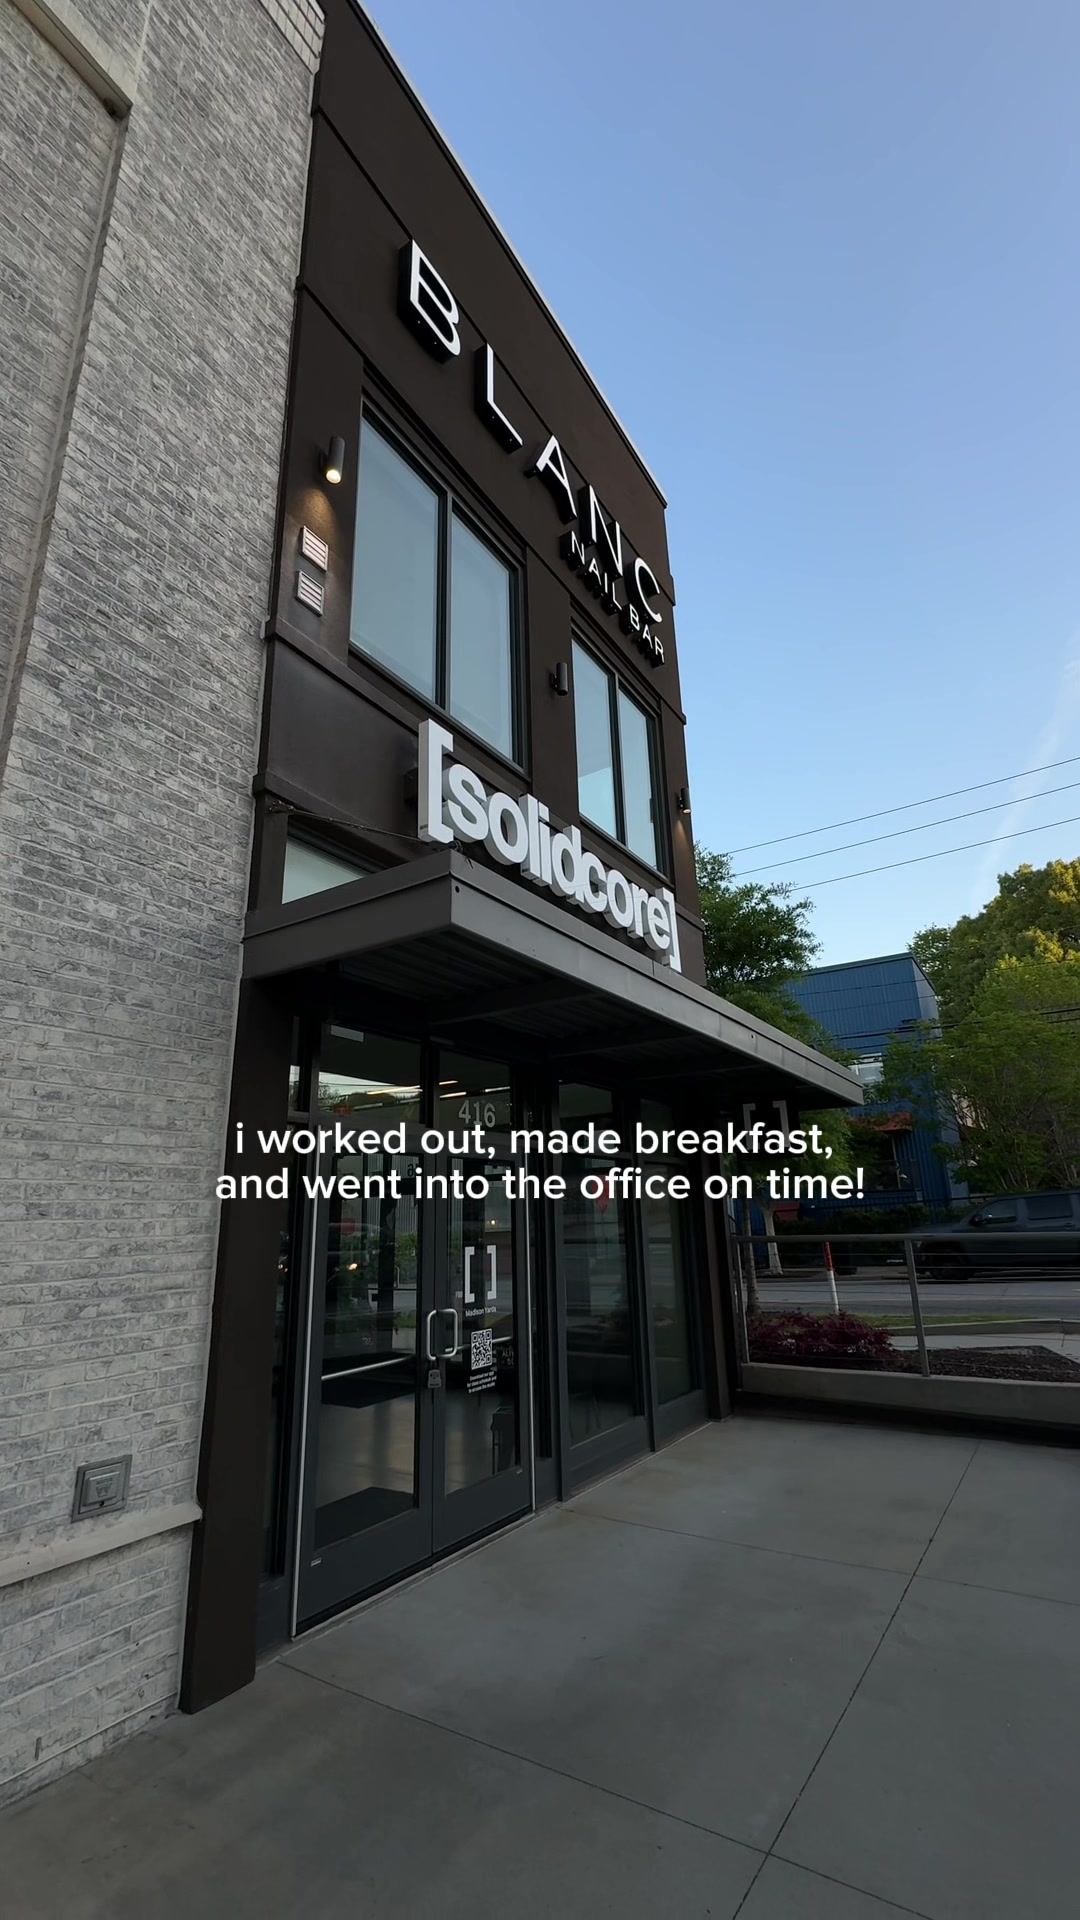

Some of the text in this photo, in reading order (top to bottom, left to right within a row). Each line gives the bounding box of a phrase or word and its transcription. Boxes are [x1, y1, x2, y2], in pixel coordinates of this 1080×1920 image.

[407, 239, 663, 623] BLANC
[571, 530, 665, 663] NAIL BAR
[458, 1100, 496, 1128] 416
